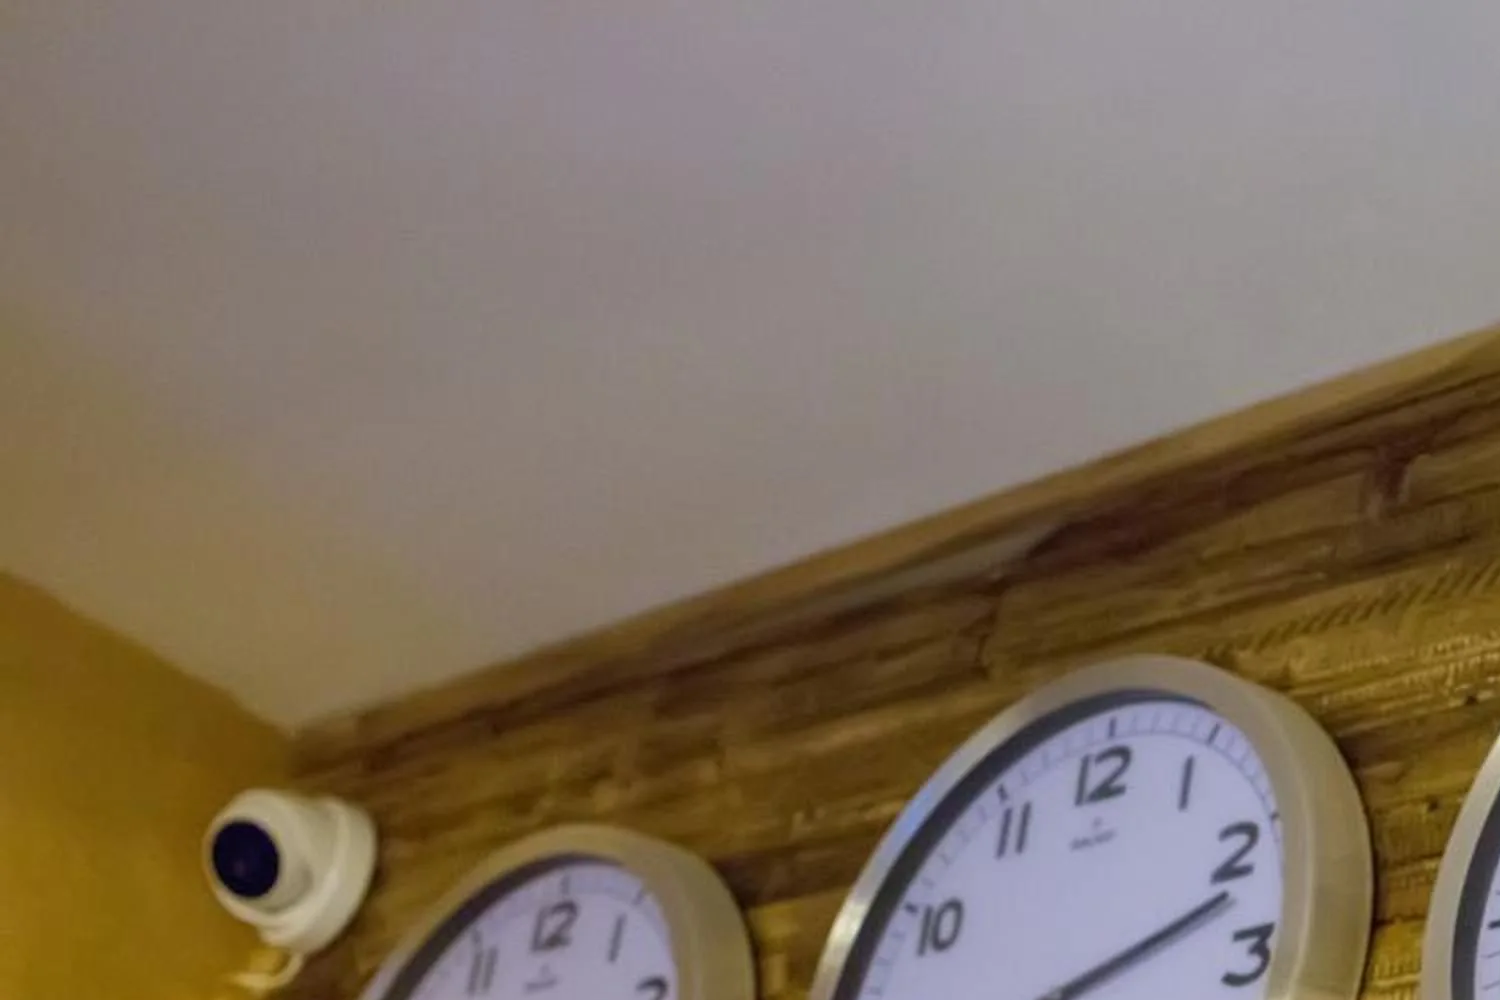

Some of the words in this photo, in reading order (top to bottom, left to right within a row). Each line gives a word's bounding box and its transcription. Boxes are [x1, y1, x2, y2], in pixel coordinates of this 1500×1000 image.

[1073, 745, 1133, 808] 12
[1178, 755, 1195, 810] 1
[995, 803, 1031, 858] 11
[1209, 821, 1260, 884] 2
[530, 902, 578, 954] 12
[608, 912, 626, 963] 1
[915, 896, 965, 956] 10
[466, 947, 498, 996] 11
[1220, 923, 1275, 986] 3
